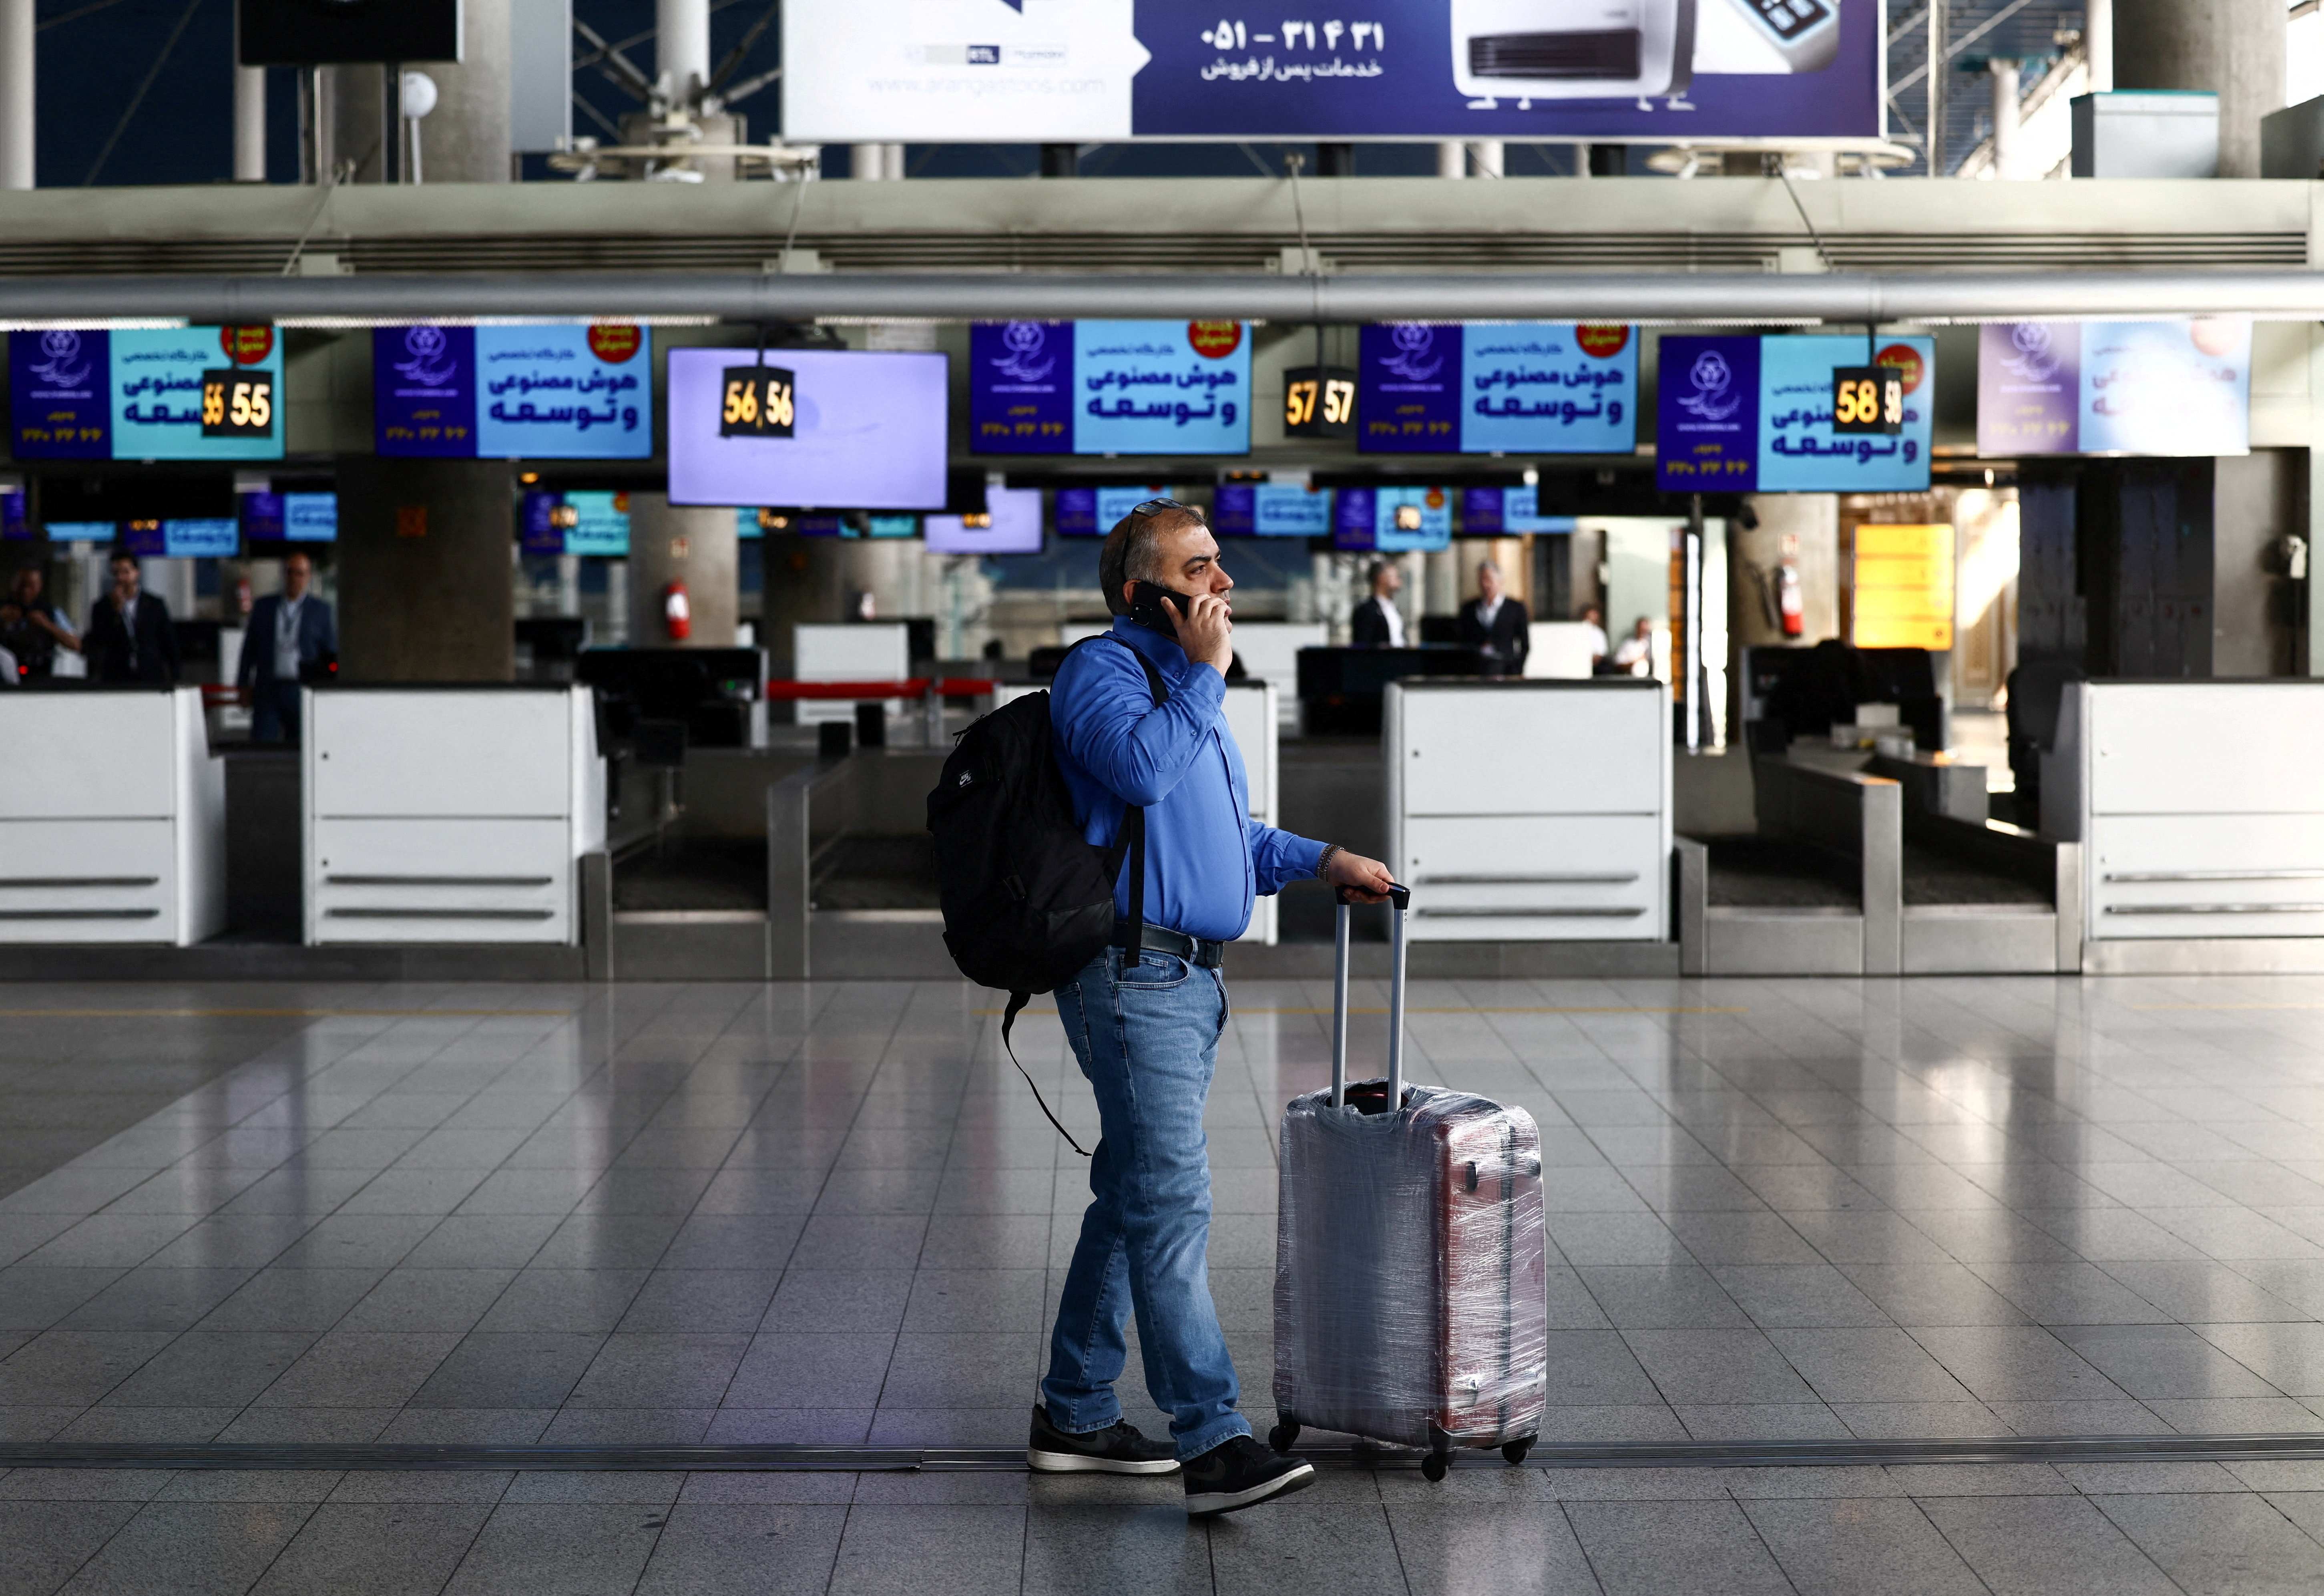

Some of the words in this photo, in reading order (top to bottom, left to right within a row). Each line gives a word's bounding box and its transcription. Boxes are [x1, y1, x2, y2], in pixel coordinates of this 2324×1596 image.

[1201, 56, 1259, 81] فروش
[1257, 55, 1274, 81] از
[1274, 63, 1312, 82] پس
[1312, 57, 1383, 77] خدمات
[488, 370, 574, 395] مصنوعی
[578, 368, 638, 393] هوش
[1087, 366, 1173, 391] مصنوعی
[1176, 364, 1237, 388] هوش
[1474, 365, 1560, 390] مصنوعی
[1563, 362, 1624, 387] هوش
[203, 383, 224, 425] 55
[230, 382, 270, 427] 55
[488, 398, 617, 431] توسعه
[723, 380, 758, 424] 56
[765, 380, 794, 427] 56
[1087, 394, 1216, 428] توسعه
[1220, 401, 1237, 427] و
[1286, 380, 1318, 425] 57
[1324, 380, 1355, 424] 57
[1474, 392, 1603, 425] توسعه
[1606, 400, 1623, 426] و
[1835, 380, 1879, 423] 58
[623, 405, 638, 431] و
[1903, 440, 1917, 465] و
